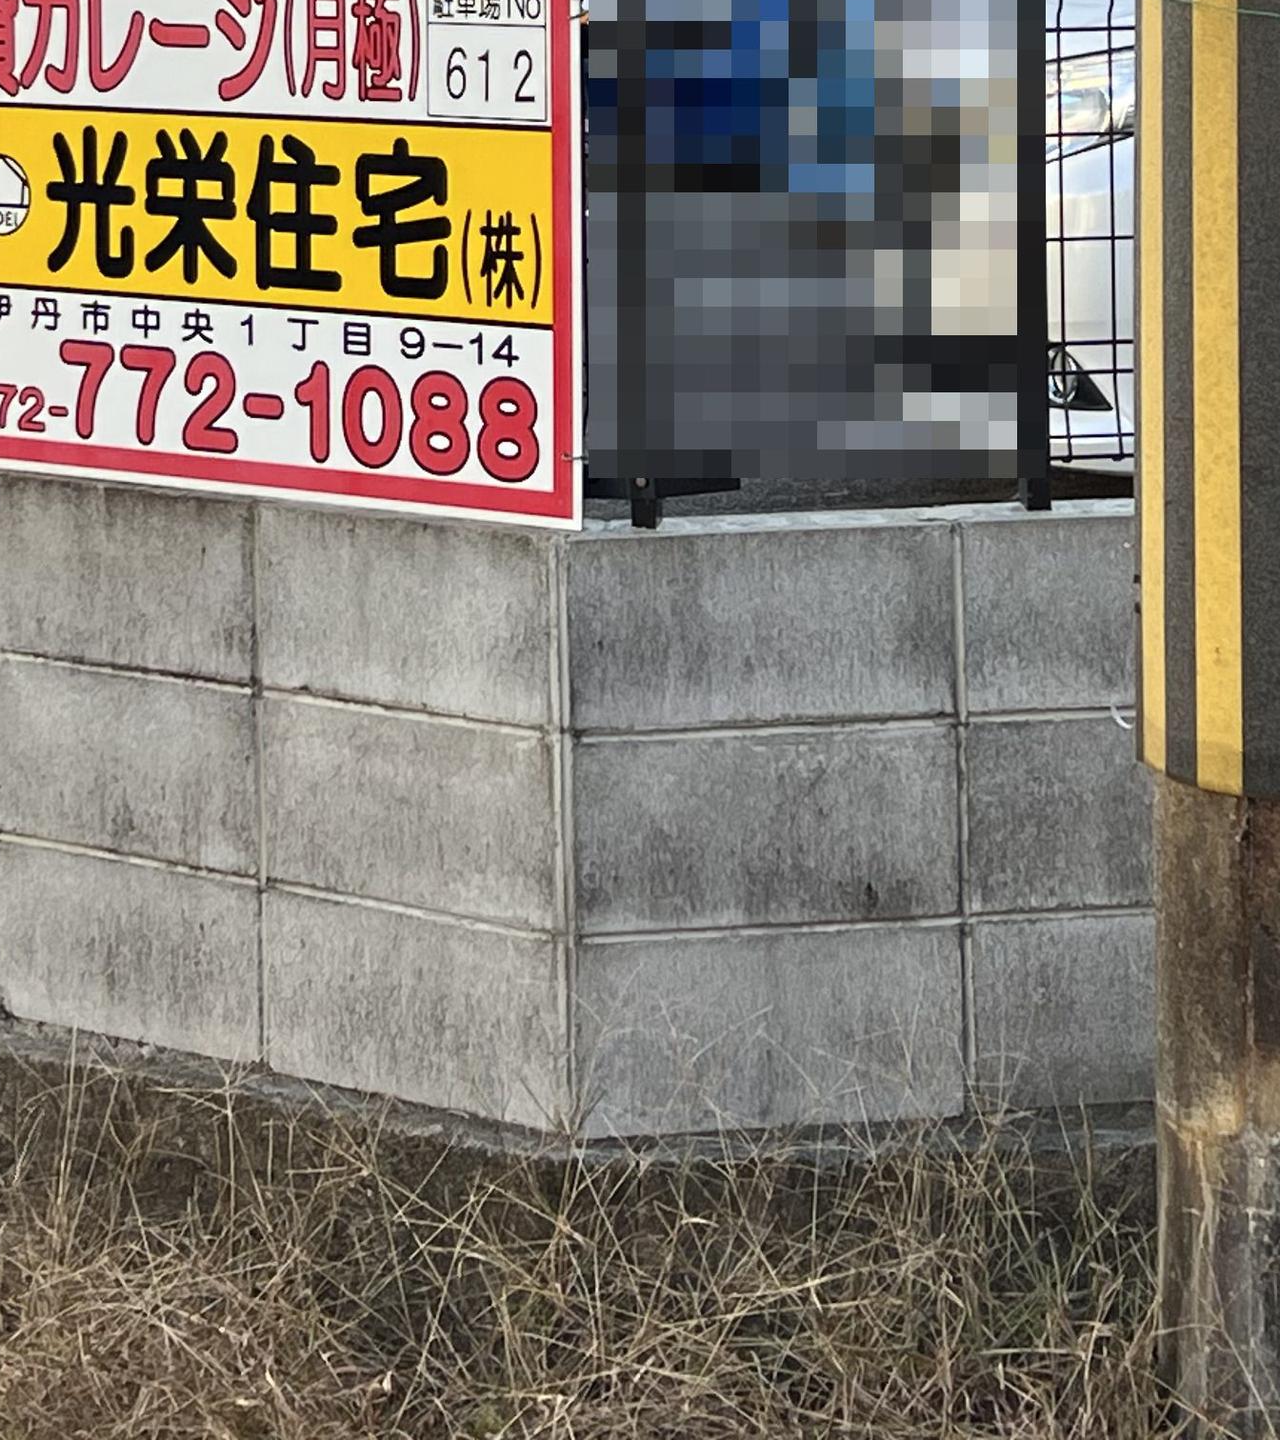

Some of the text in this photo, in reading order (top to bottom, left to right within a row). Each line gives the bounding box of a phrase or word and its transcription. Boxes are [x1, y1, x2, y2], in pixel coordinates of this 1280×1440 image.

[445, 46, 536, 103] 612
[46, 125, 542, 310] 光栄住宅(株)
